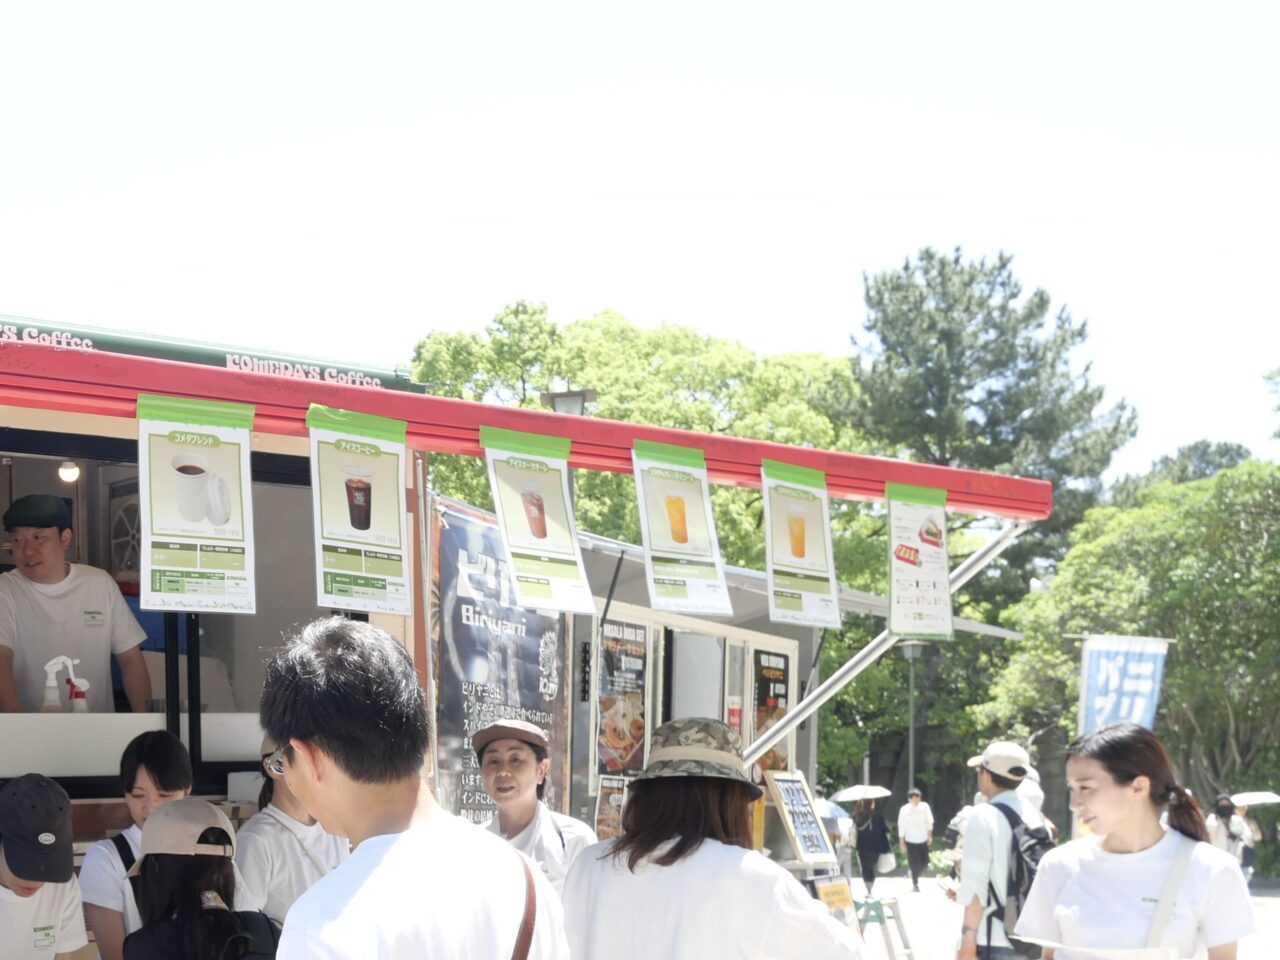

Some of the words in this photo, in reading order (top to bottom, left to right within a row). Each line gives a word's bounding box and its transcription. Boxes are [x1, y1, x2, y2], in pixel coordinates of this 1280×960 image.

[225, 353, 321, 382] KOMEDA'S
[173, 433, 215, 447] コメダブレンド
[339, 441, 379, 456] アイスコーヒー
[461, 604, 527, 638] Biriyani
